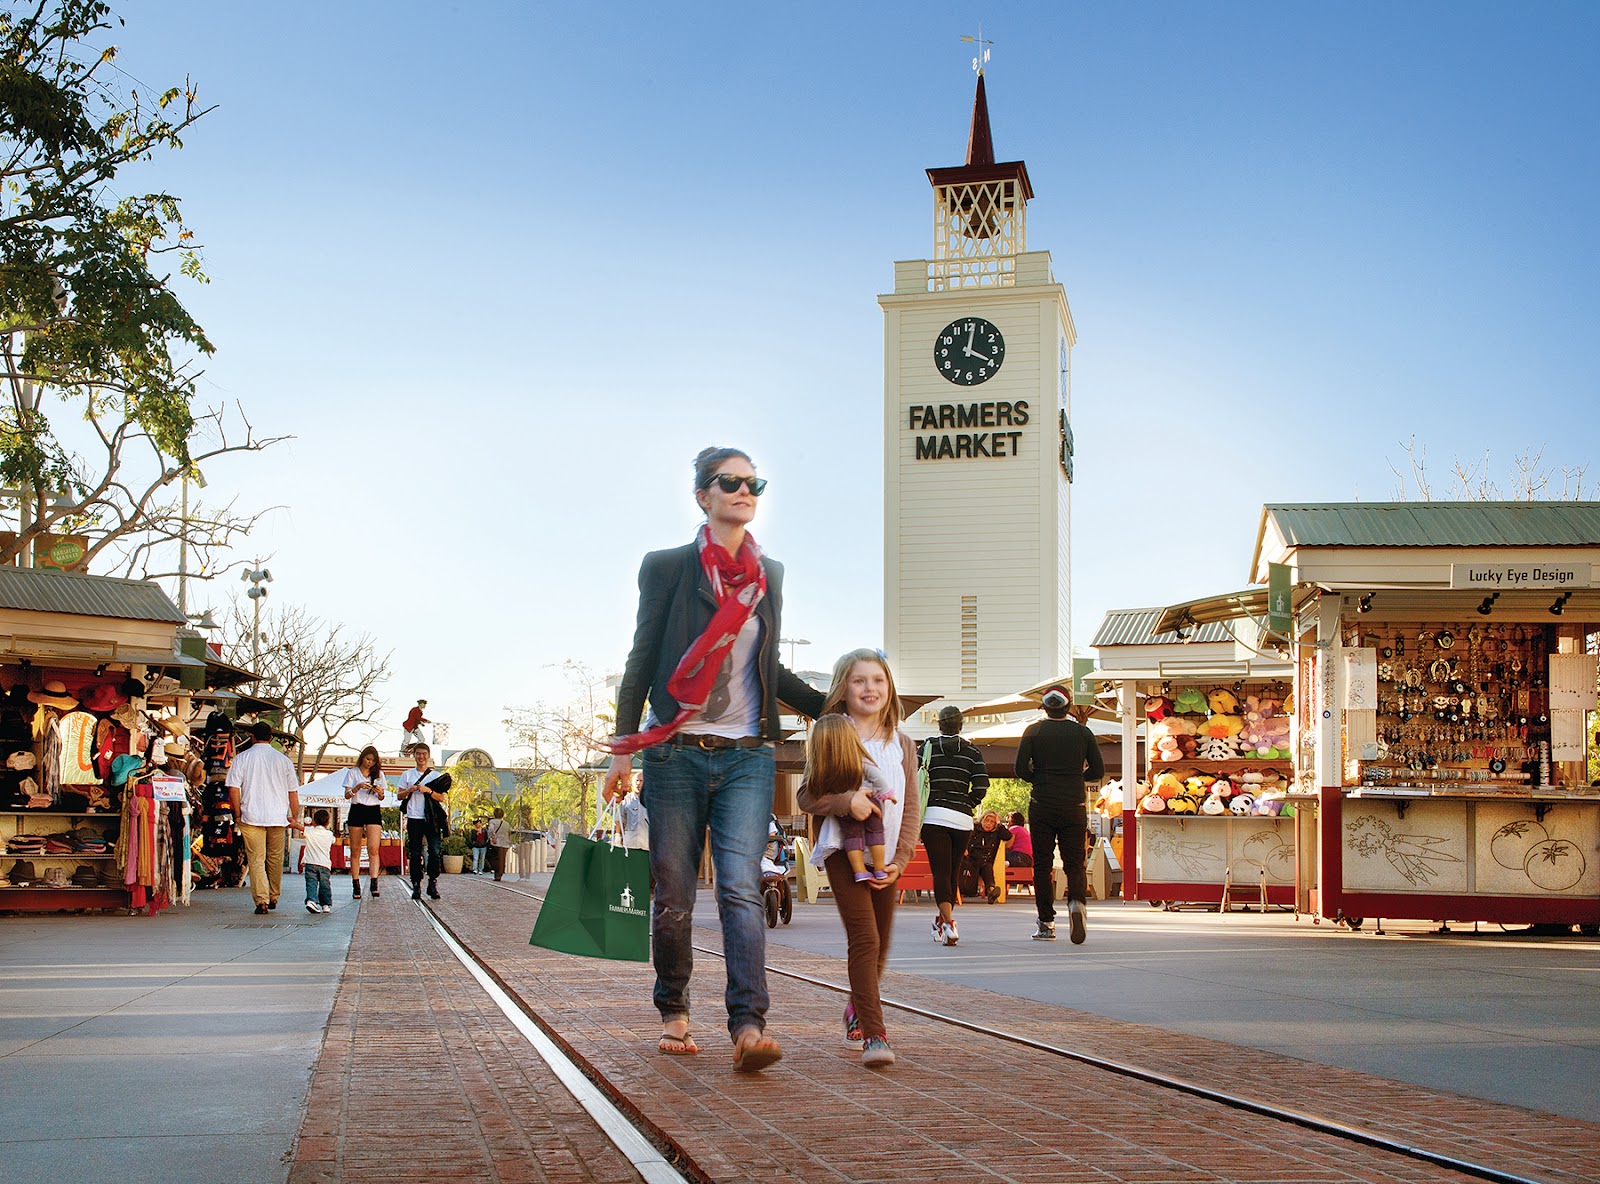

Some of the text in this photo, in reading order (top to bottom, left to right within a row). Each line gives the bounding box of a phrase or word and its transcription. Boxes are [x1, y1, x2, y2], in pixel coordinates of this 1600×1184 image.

[953, 326, 960, 335] 11
[964, 323, 975, 332] 12
[980, 325, 984, 334] 1
[943, 336, 952, 345] 10
[988, 334, 995, 343] 2
[941, 348, 948, 357] 9
[991, 346, 998, 354] 3
[944, 361, 951, 369] 8
[987, 359, 994, 367] 4
[954, 369, 961, 378] 7
[966, 372, 973, 380] 6
[979, 368, 986, 376] 5
[909, 400, 1029, 429] FARMERS
[916, 431, 1022, 460] MARKET
[1469, 568, 1574, 583] Lucky Eye Design
[334, 756, 396, 765] GILRE
